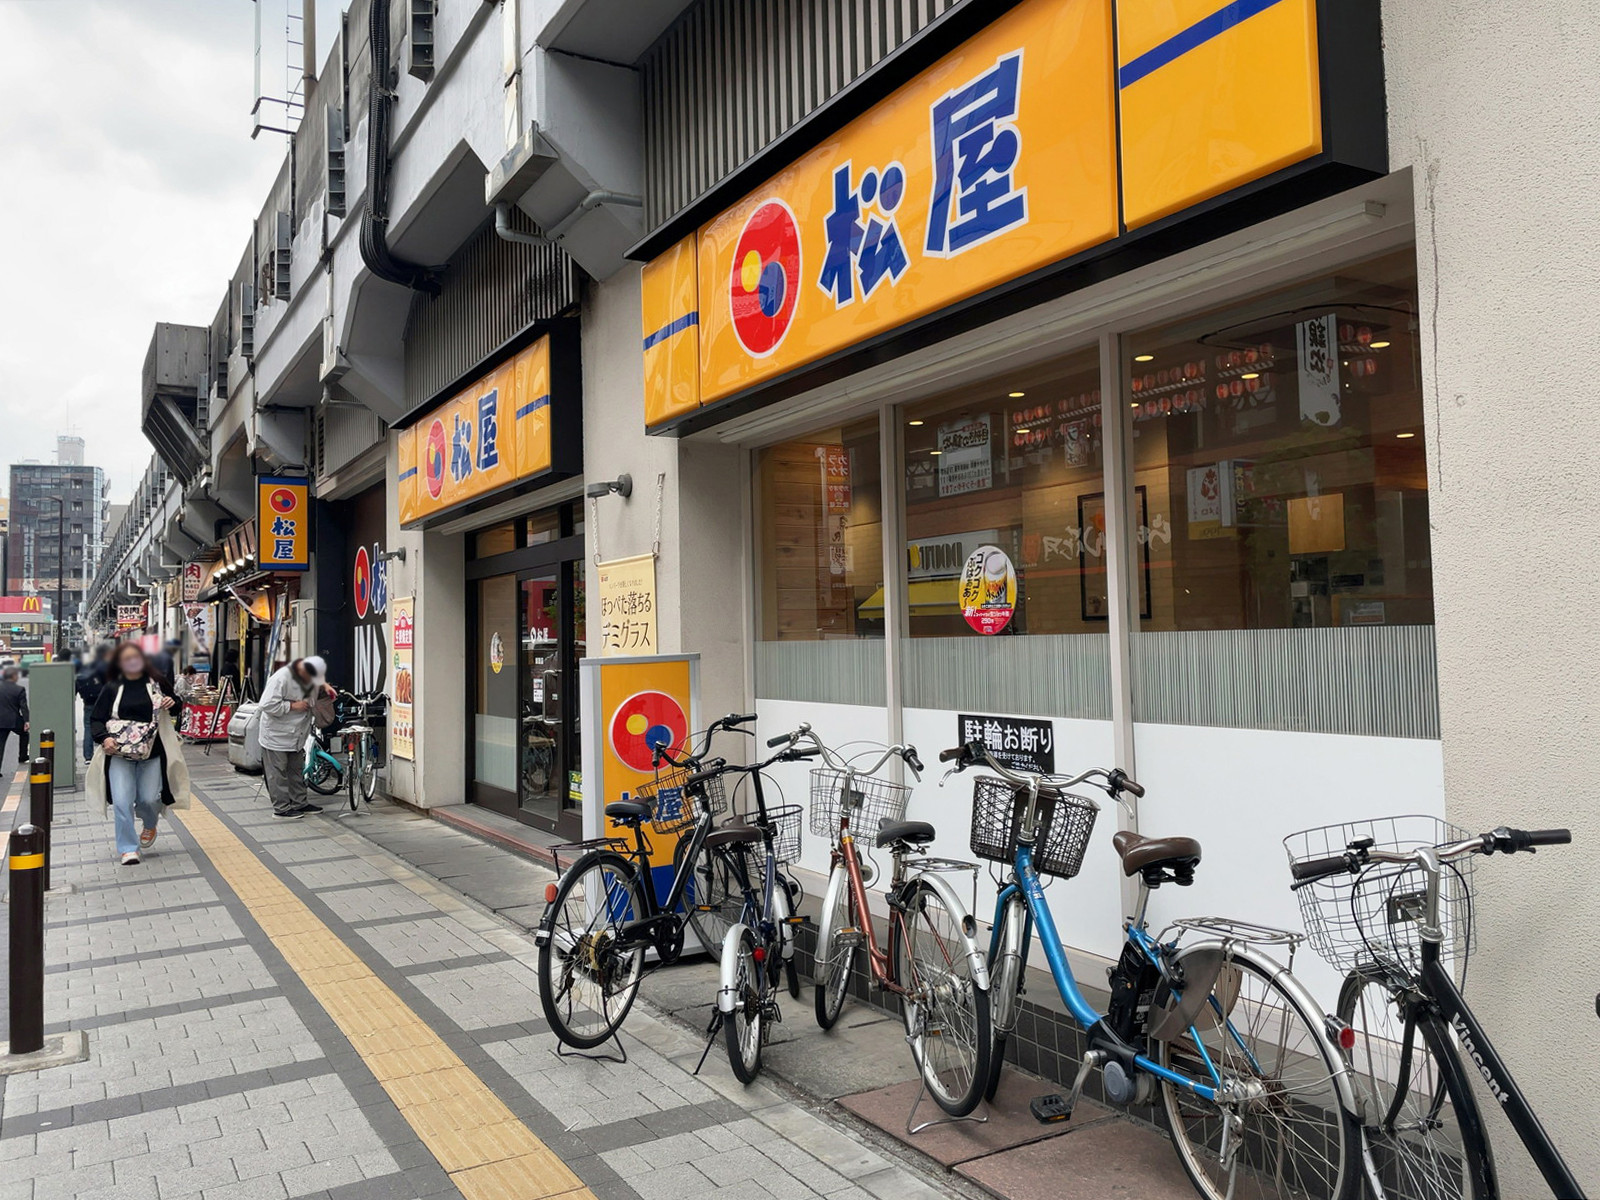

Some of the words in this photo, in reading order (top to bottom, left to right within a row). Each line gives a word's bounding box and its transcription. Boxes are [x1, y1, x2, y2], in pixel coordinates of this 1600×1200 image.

[816, 46, 1029, 311] 松屋
[450, 387, 499, 484] 松屋
[271, 516, 297, 561] 松屋
[186, 563, 201, 579] 肉
[971, 551, 985, 602] ゴクゴク
[602, 591, 652, 616] ほっぺた落ちる
[602, 619, 651, 650] デミグラス
[964, 719, 1052, 753] 駐輪お断り
[1451, 1011, 1510, 1105] Vincent
